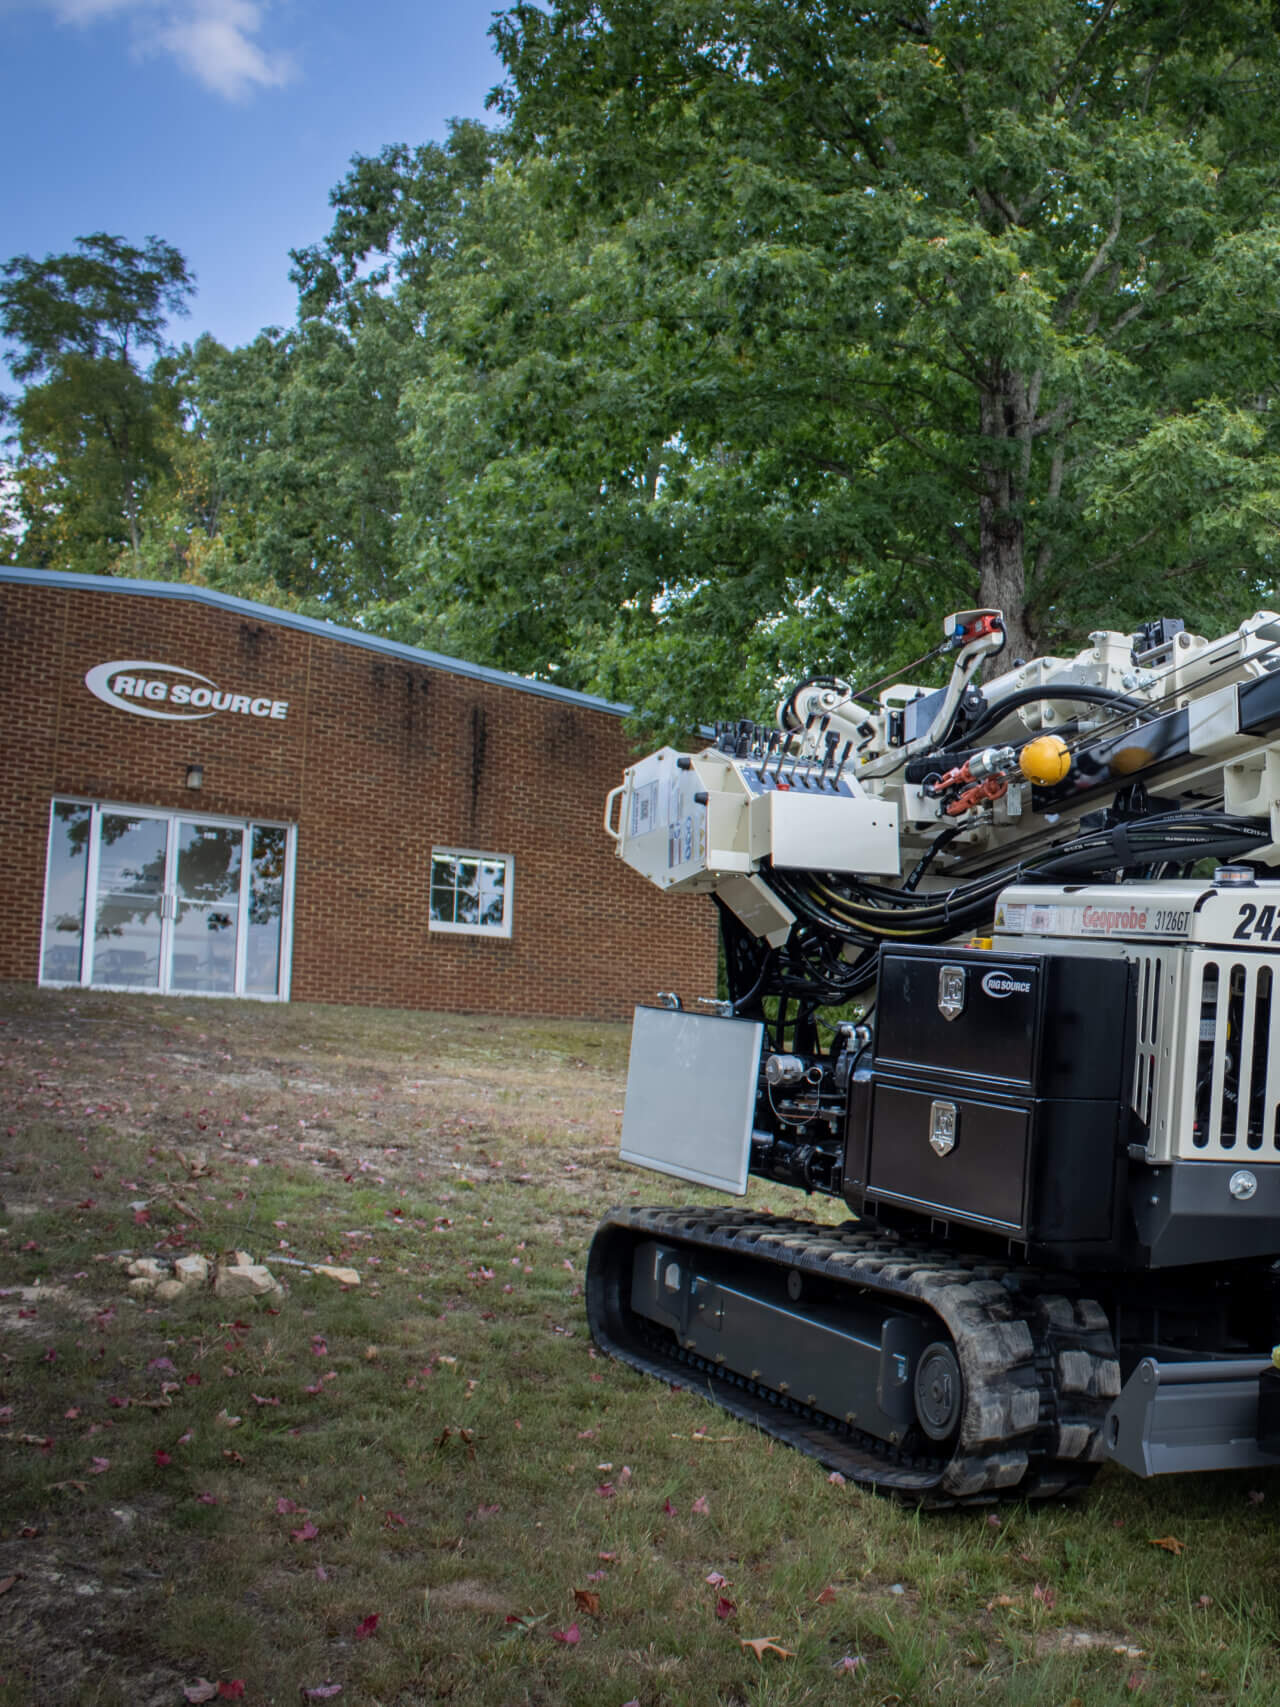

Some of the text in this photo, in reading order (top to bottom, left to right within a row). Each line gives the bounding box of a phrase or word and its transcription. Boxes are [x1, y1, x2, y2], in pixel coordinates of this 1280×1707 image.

[113, 675, 289, 720] RIG SOURCE
[1082, 904, 1190, 934] Geoprobe 3126GT
[988, 979, 1031, 993] RIG SOURCE
